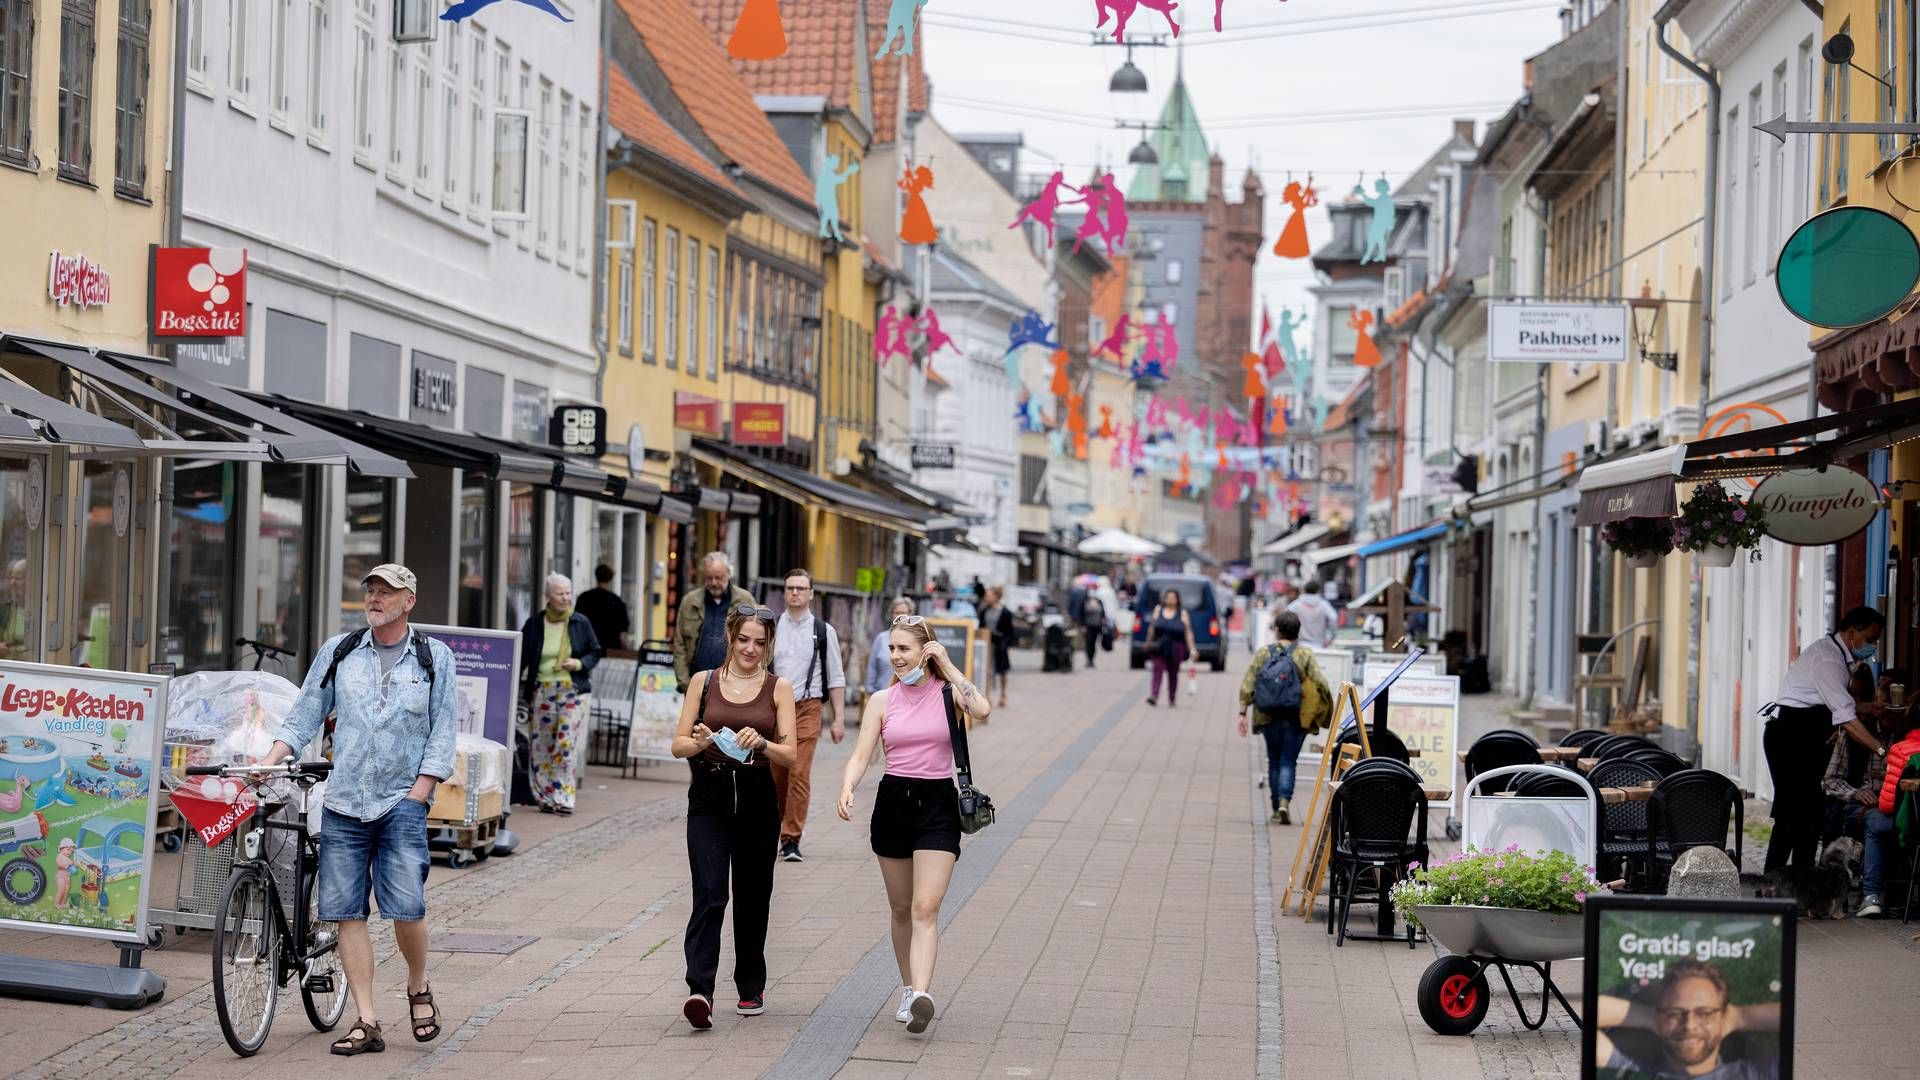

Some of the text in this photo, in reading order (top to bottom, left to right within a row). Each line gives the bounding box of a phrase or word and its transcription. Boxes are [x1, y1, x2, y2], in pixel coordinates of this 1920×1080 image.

[159, 310, 241, 332] Bog&idé
[1519, 330, 1597, 345] Pakhuset
[1762, 487, 1865, 520] D'angelo
[45, 716, 106, 736] Vandleg
[1405, 736, 1444, 752] ALE
[1618, 933, 1756, 961] Gratis glas?
[1618, 957, 1665, 979] Yes!
